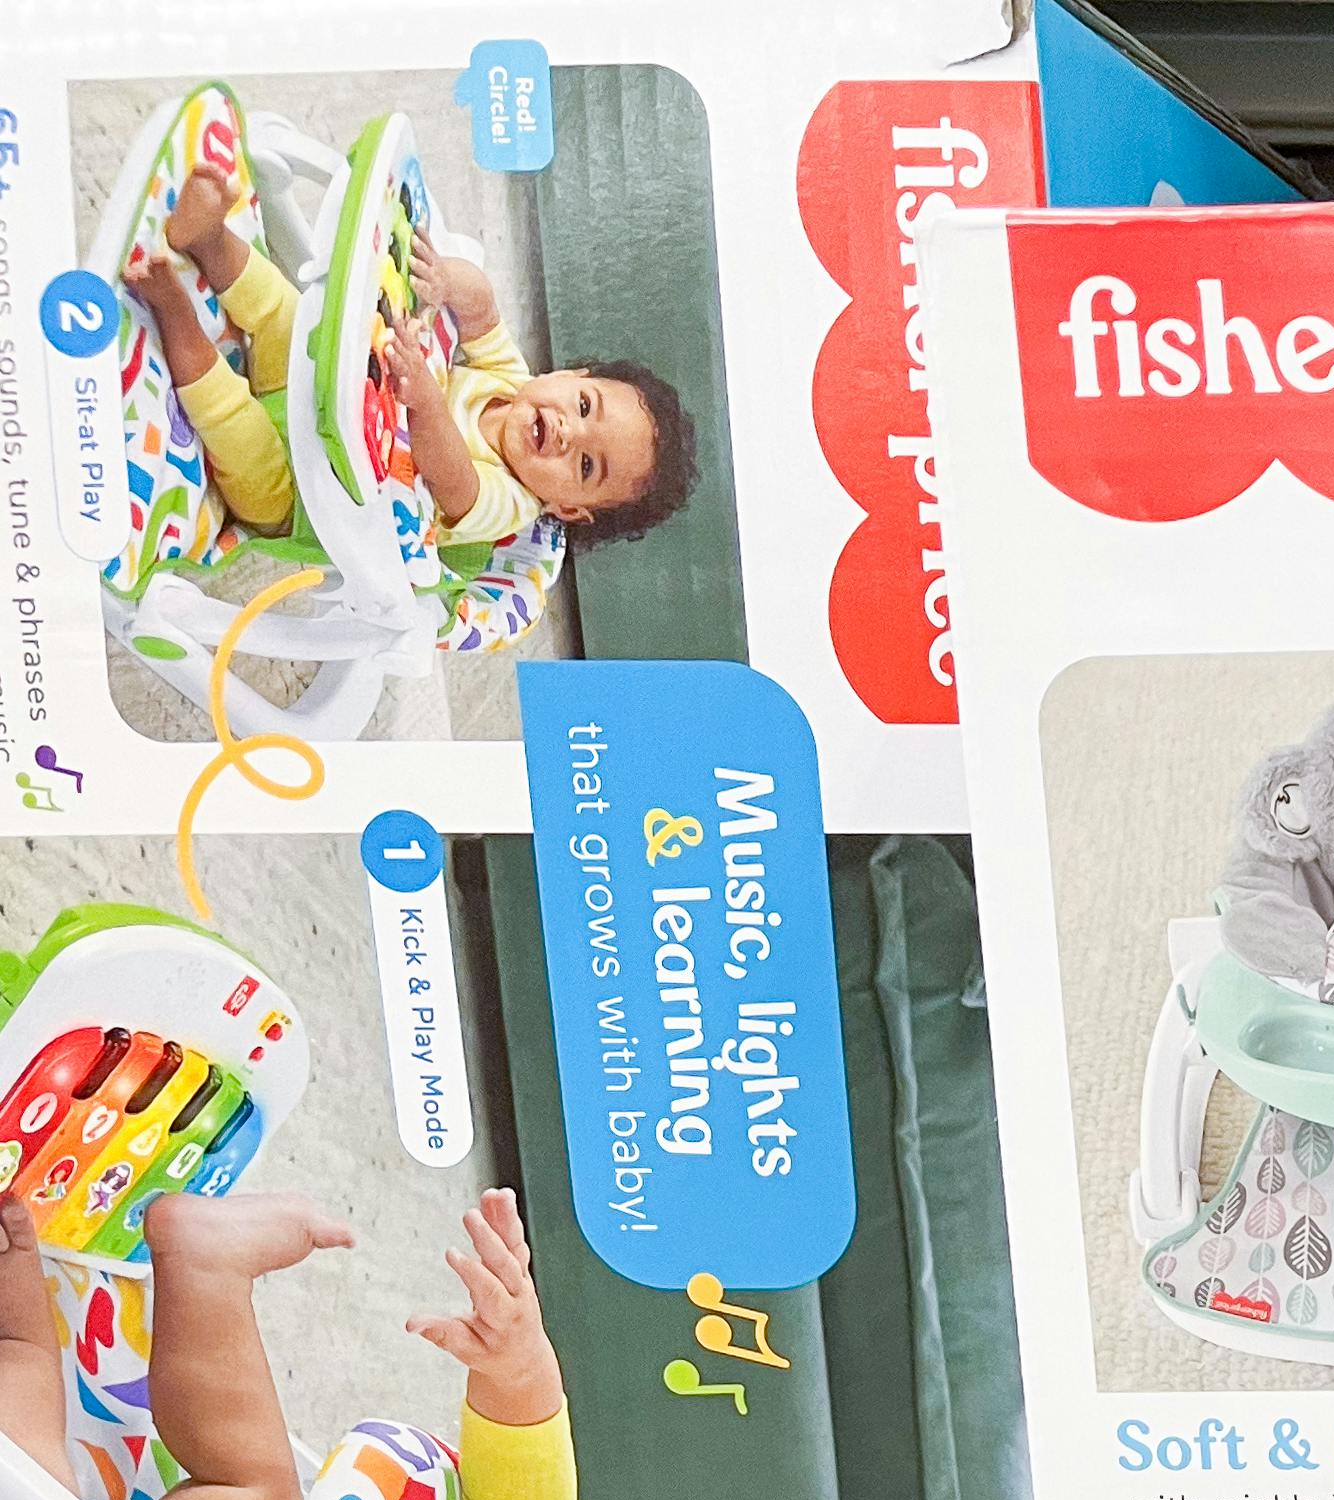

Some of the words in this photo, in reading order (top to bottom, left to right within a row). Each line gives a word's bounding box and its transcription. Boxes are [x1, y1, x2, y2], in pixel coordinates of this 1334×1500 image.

[488, 65, 512, 144] Circle!
[515, 77, 536, 131] Red!
[60, 300, 104, 332] 2
[0, 339, 27, 463] sounds,
[75, 377, 99, 451] Sit-at
[7, 479, 31, 551] tune
[80, 463, 105, 522] Play
[16, 563, 41, 583] &
[12, 598, 47, 722] phrases
[568, 722, 611, 815] that
[383, 838, 428, 860] 1
[642, 807, 704, 868] &
[712, 767, 783, 980] Music,
[399, 908, 428, 966] Kick
[569, 832, 621, 978] grows
[408, 977, 431, 996] &
[651, 886, 713, 1156] learning
[411, 1007, 436, 1065] Play
[595, 996, 642, 1093] with
[419, 1074, 449, 1150] Mode
[710, 1001, 800, 1178] lights
[608, 1110, 659, 1233] baby!
[1115, 1417, 1248, 1472] Soft
[1267, 1416, 1320, 1472] &
